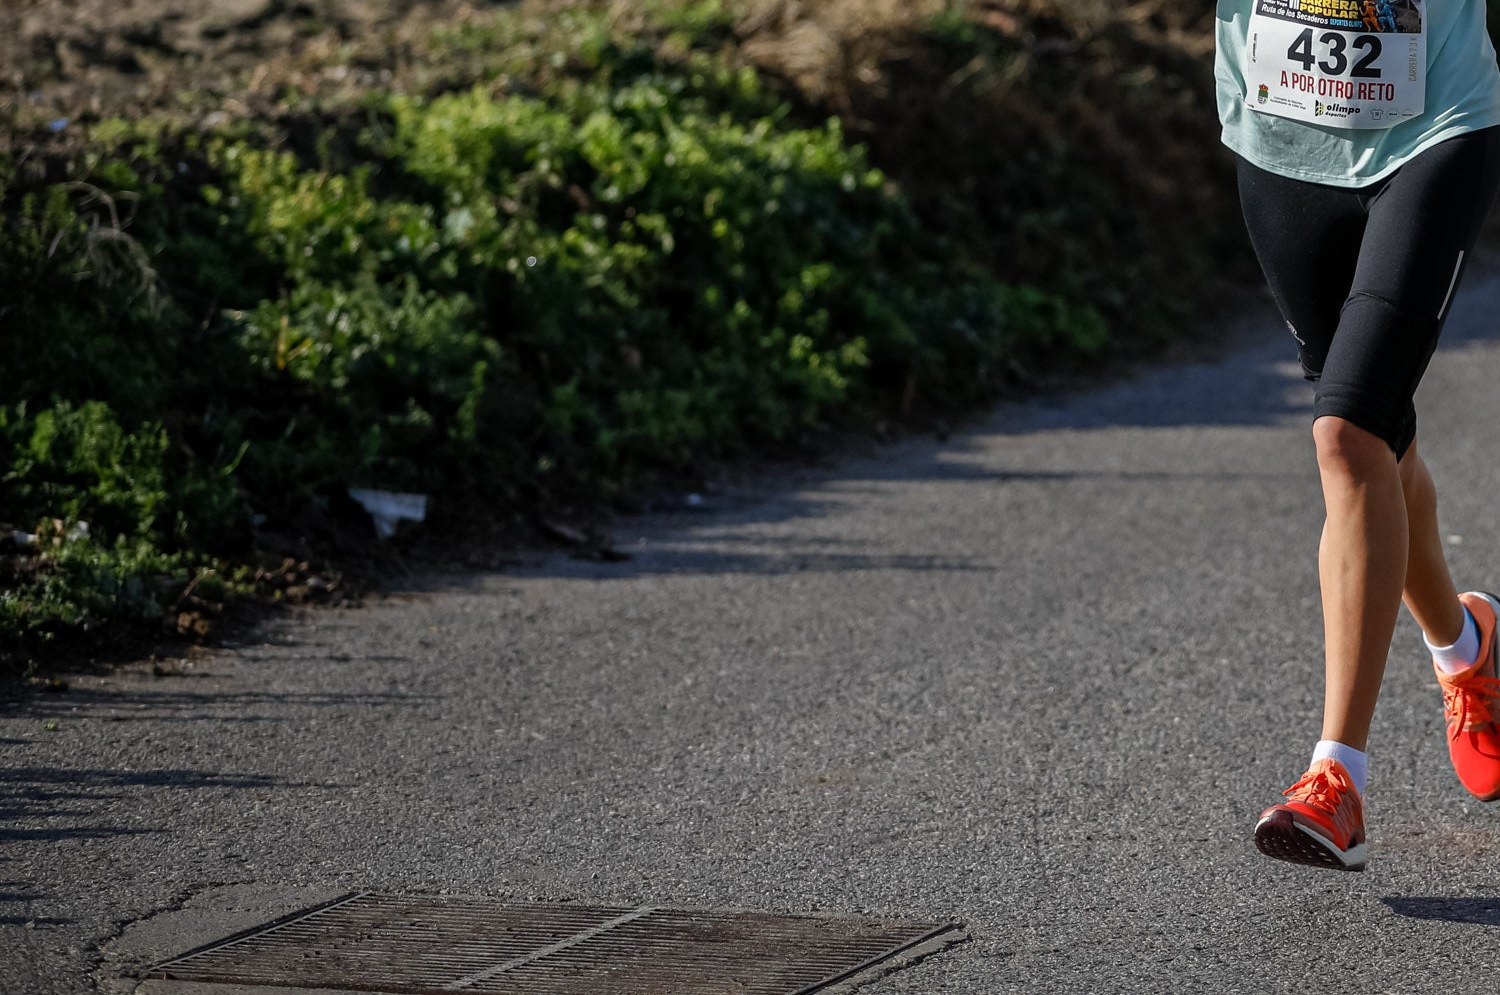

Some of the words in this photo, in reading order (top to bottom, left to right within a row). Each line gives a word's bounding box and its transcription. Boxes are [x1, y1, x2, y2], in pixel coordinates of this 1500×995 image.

[1261, 3, 1276, 14] Ruta
[1277, 7, 1285, 16] de
[1285, 9, 1296, 18] los
[1296, 11, 1329, 25] Secaderos
[1299, 3, 1359, 19] POPULAR
[1329, 18, 1348, 27] DEPORTES
[1287, 28, 1383, 78] 432
[1408, 53, 1418, 83] CARRERA
[1280, 70, 1289, 88] A
[1291, 73, 1315, 94] POR
[1318, 77, 1354, 100] OTRO
[1357, 82, 1395, 102] RETO
[1325, 111, 1347, 119] deportes
[1326, 103, 1361, 115] olimpo
